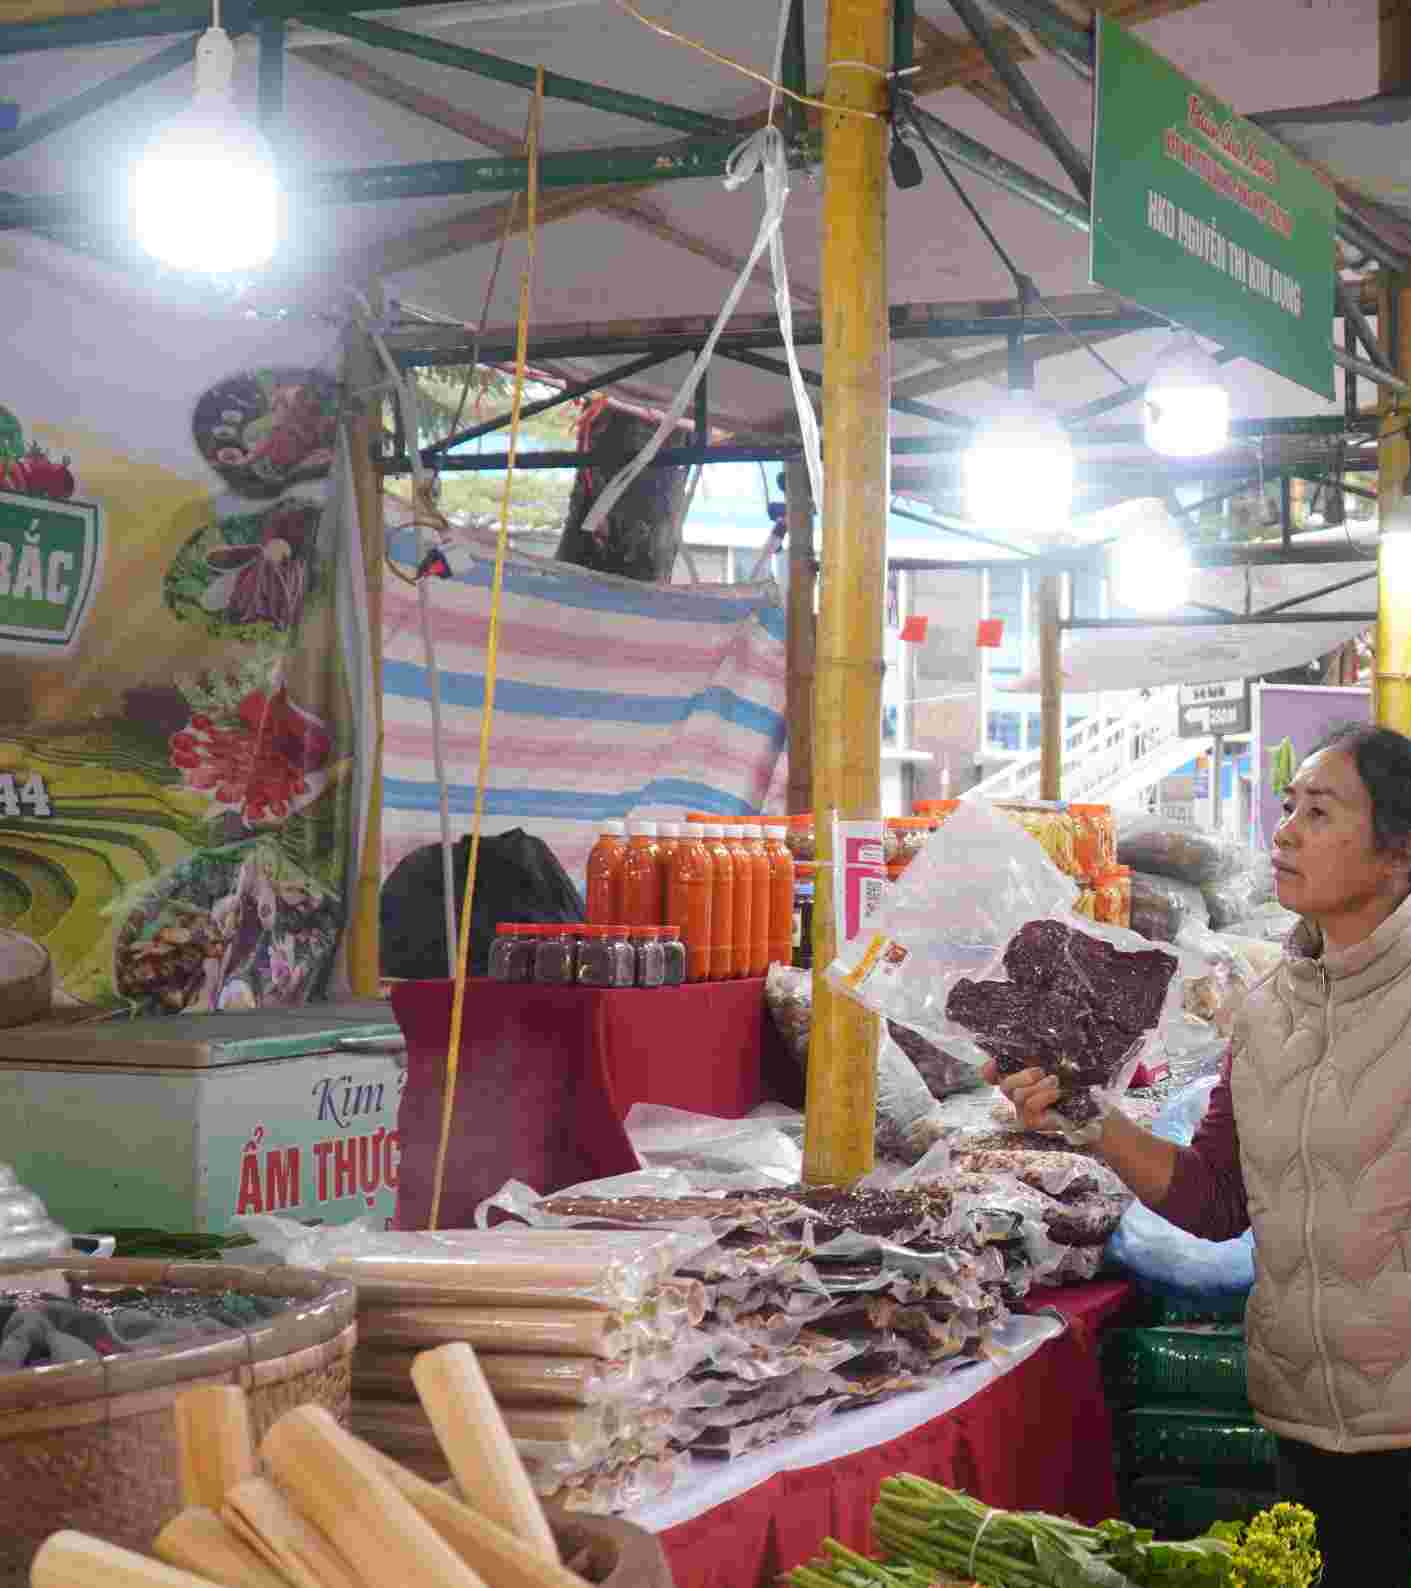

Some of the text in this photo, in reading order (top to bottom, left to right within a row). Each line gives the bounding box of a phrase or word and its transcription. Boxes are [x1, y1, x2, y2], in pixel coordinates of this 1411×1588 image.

[312, 1075, 384, 1128] Kim
[236, 1124, 401, 1215] ẨM THỰC
